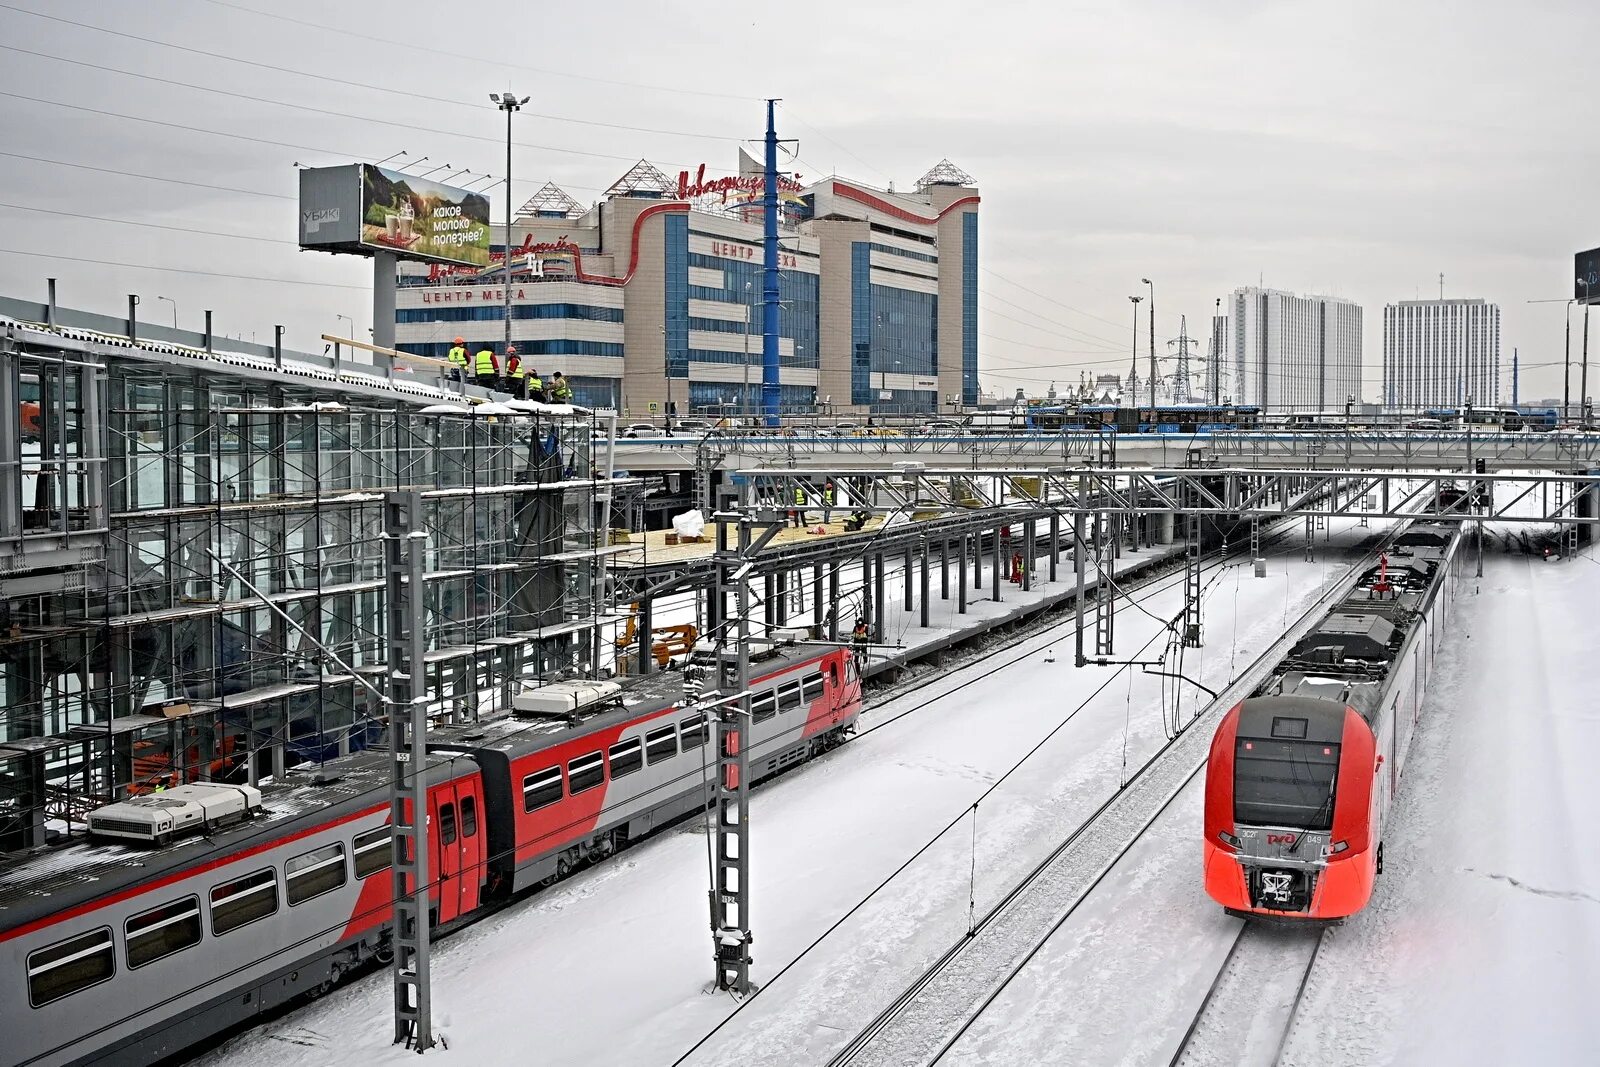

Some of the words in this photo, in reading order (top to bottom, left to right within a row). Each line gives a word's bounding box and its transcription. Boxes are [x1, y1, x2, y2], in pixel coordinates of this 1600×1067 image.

[433, 205, 462, 219] какое
[433, 217, 470, 231] молоко
[433, 227, 484, 247] полезнее?
[712, 241, 754, 260] ЦЕНТР
[423, 290, 473, 304] ЦЕНТР
[399, 753, 408, 761] 55
[1307, 835, 1322, 844] 049
